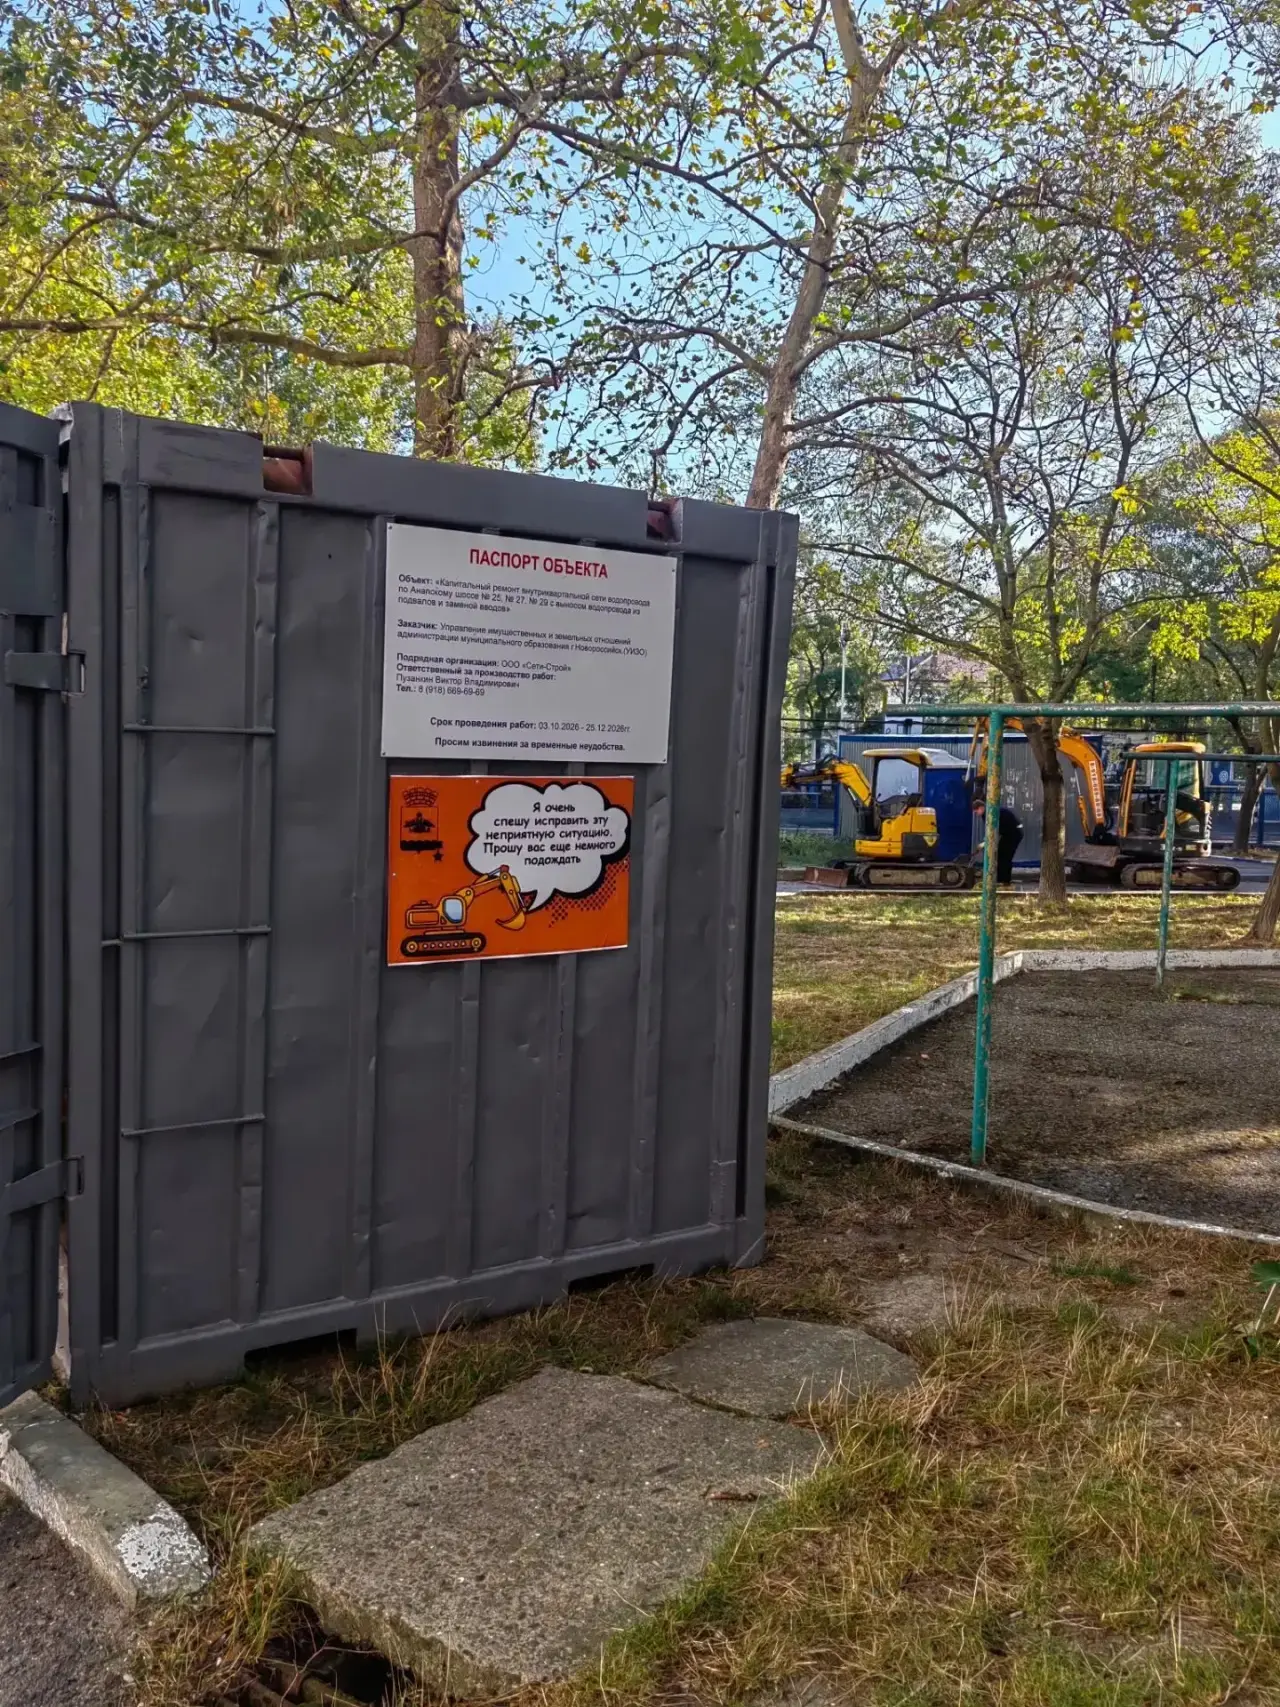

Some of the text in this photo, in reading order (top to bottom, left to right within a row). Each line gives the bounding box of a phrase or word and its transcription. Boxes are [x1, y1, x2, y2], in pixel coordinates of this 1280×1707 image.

[469, 548, 608, 578] ПАСПОРТ ОБЪЕКТА
[398, 574, 650, 607] Объект: «Капитальный ремонт внутриквартальной сети водопровода
[398, 596, 436, 606] подвалов
[445, 601, 478, 610] заменой
[479, 604, 511, 613] вводов»
[410, 586, 453, 599] Анапскому
[455, 592, 479, 600] шоссе
[540, 598, 548, 606] 29
[555, 601, 587, 610] выносом
[588, 603, 632, 615] водопровода
[397, 619, 438, 630] Заказчик:
[440, 622, 486, 634] Управление
[488, 628, 546, 639] имущественных
[554, 633, 592, 642] земельных
[594, 636, 631, 645] отношений
[397, 631, 459, 642] администрации
[461, 636, 522, 647] муниципального
[524, 640, 569, 650] образования
[397, 653, 444, 664] Подрядная
[446, 657, 499, 667] организация:
[501, 660, 520, 669] ООО
[396, 663, 461, 674] Ответственный
[474, 668, 530, 679] производство
[532, 672, 557, 681] работ:
[435, 675, 462, 685] Виктор
[464, 678, 520, 688] Владимирович
[396, 684, 485, 696] Тел.: 8 (918) 669-69-69
[430, 717, 453, 728] Срок
[455, 719, 507, 730] проведения
[509, 720, 537, 731] работ:
[435, 737, 625, 752] Просим извинения за временные неудобства.
[533, 802, 576, 812] Я очень
[493, 816, 609, 830] спешу исправить эту
[485, 829, 613, 843] неприятную ситуацию.
[483, 840, 616, 856] Прошу вас еще немного
[524, 856, 581, 866] подождать
